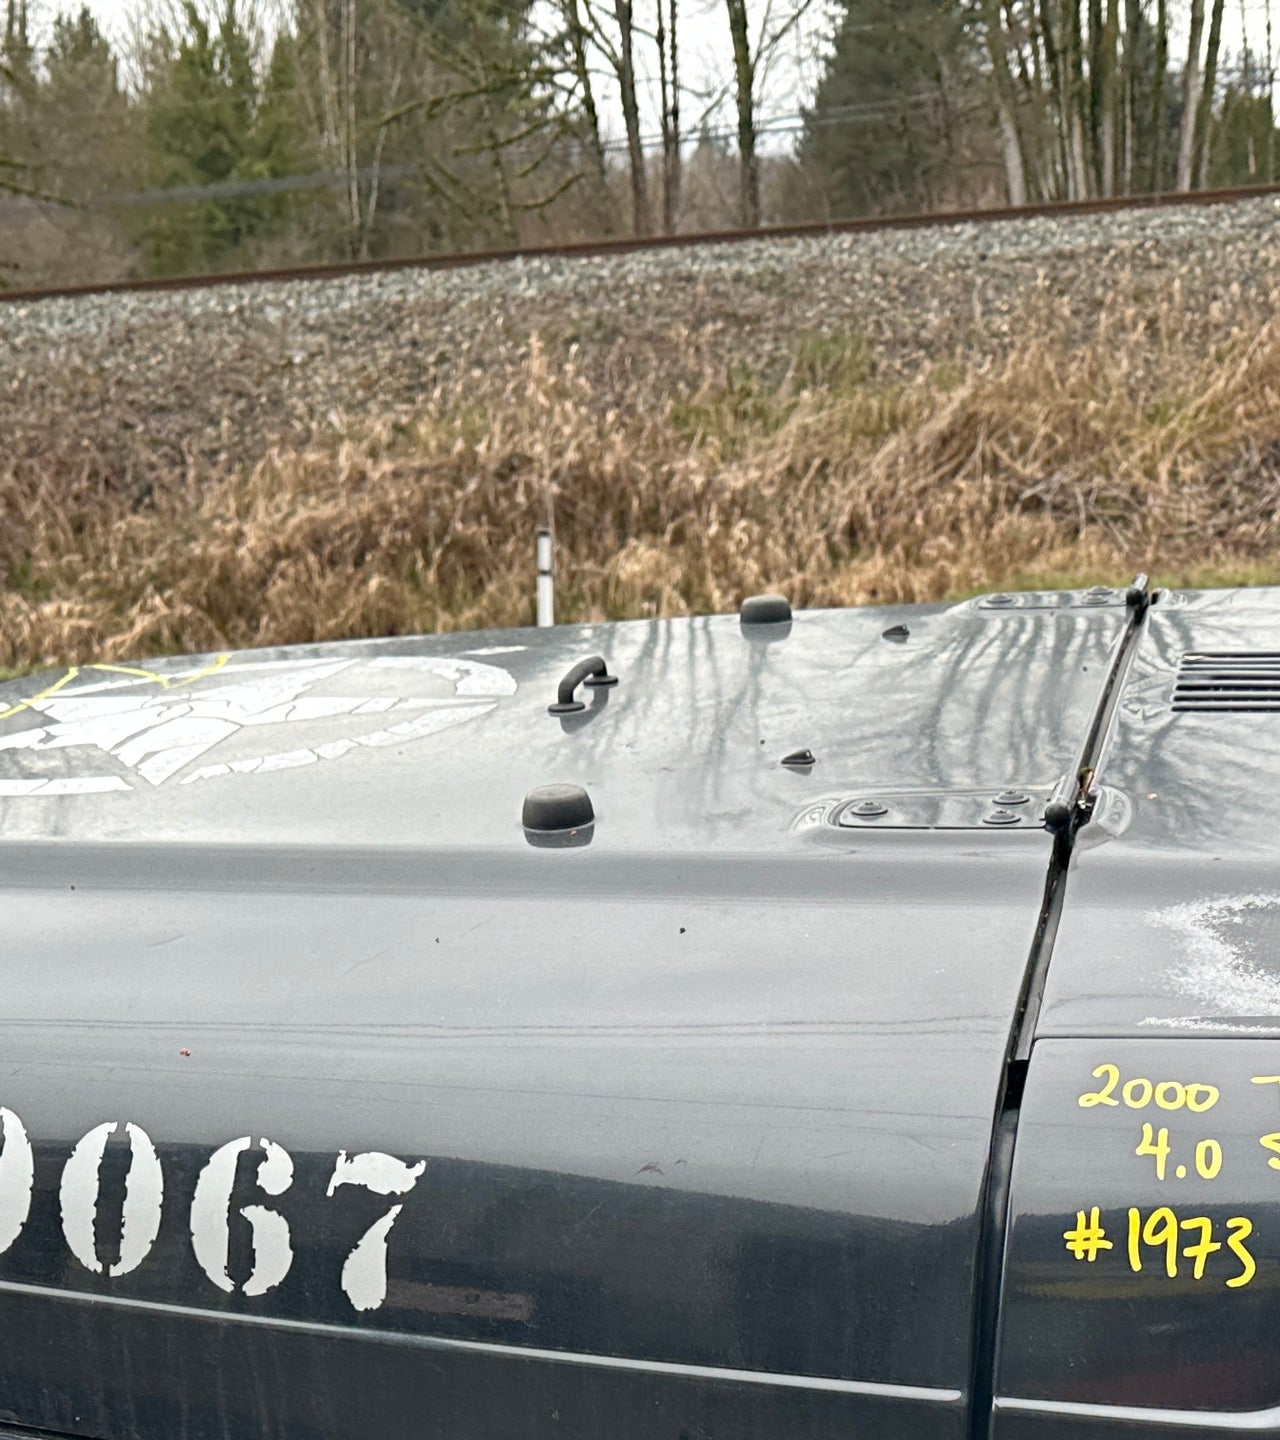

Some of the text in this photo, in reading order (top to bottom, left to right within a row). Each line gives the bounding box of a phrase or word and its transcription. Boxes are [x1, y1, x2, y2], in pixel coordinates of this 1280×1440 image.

[1078, 1064, 1219, 1112] 2000
[1135, 1123, 1222, 1180] 4.0
[1064, 1207, 1256, 1288] #1973
